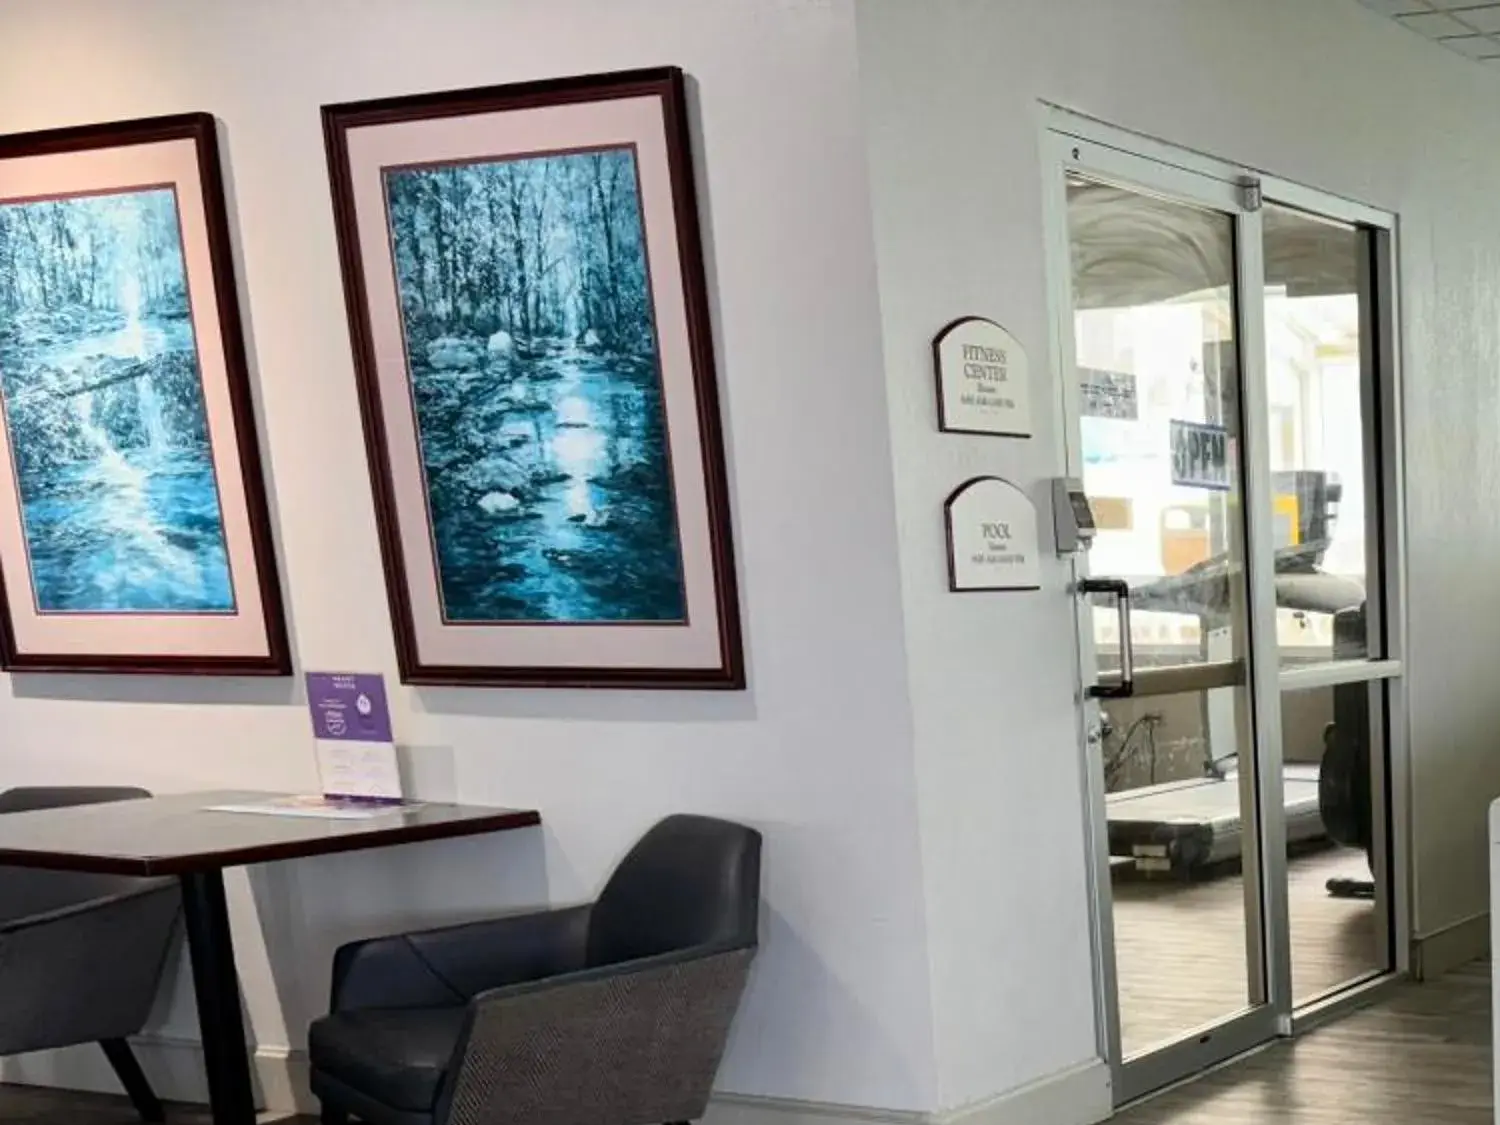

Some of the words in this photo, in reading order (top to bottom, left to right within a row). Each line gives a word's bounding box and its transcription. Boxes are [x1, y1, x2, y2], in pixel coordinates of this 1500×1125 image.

[961, 344, 1007, 364] FITNESS
[963, 363, 1008, 382] CENTER
[981, 522, 1012, 540] POOL
